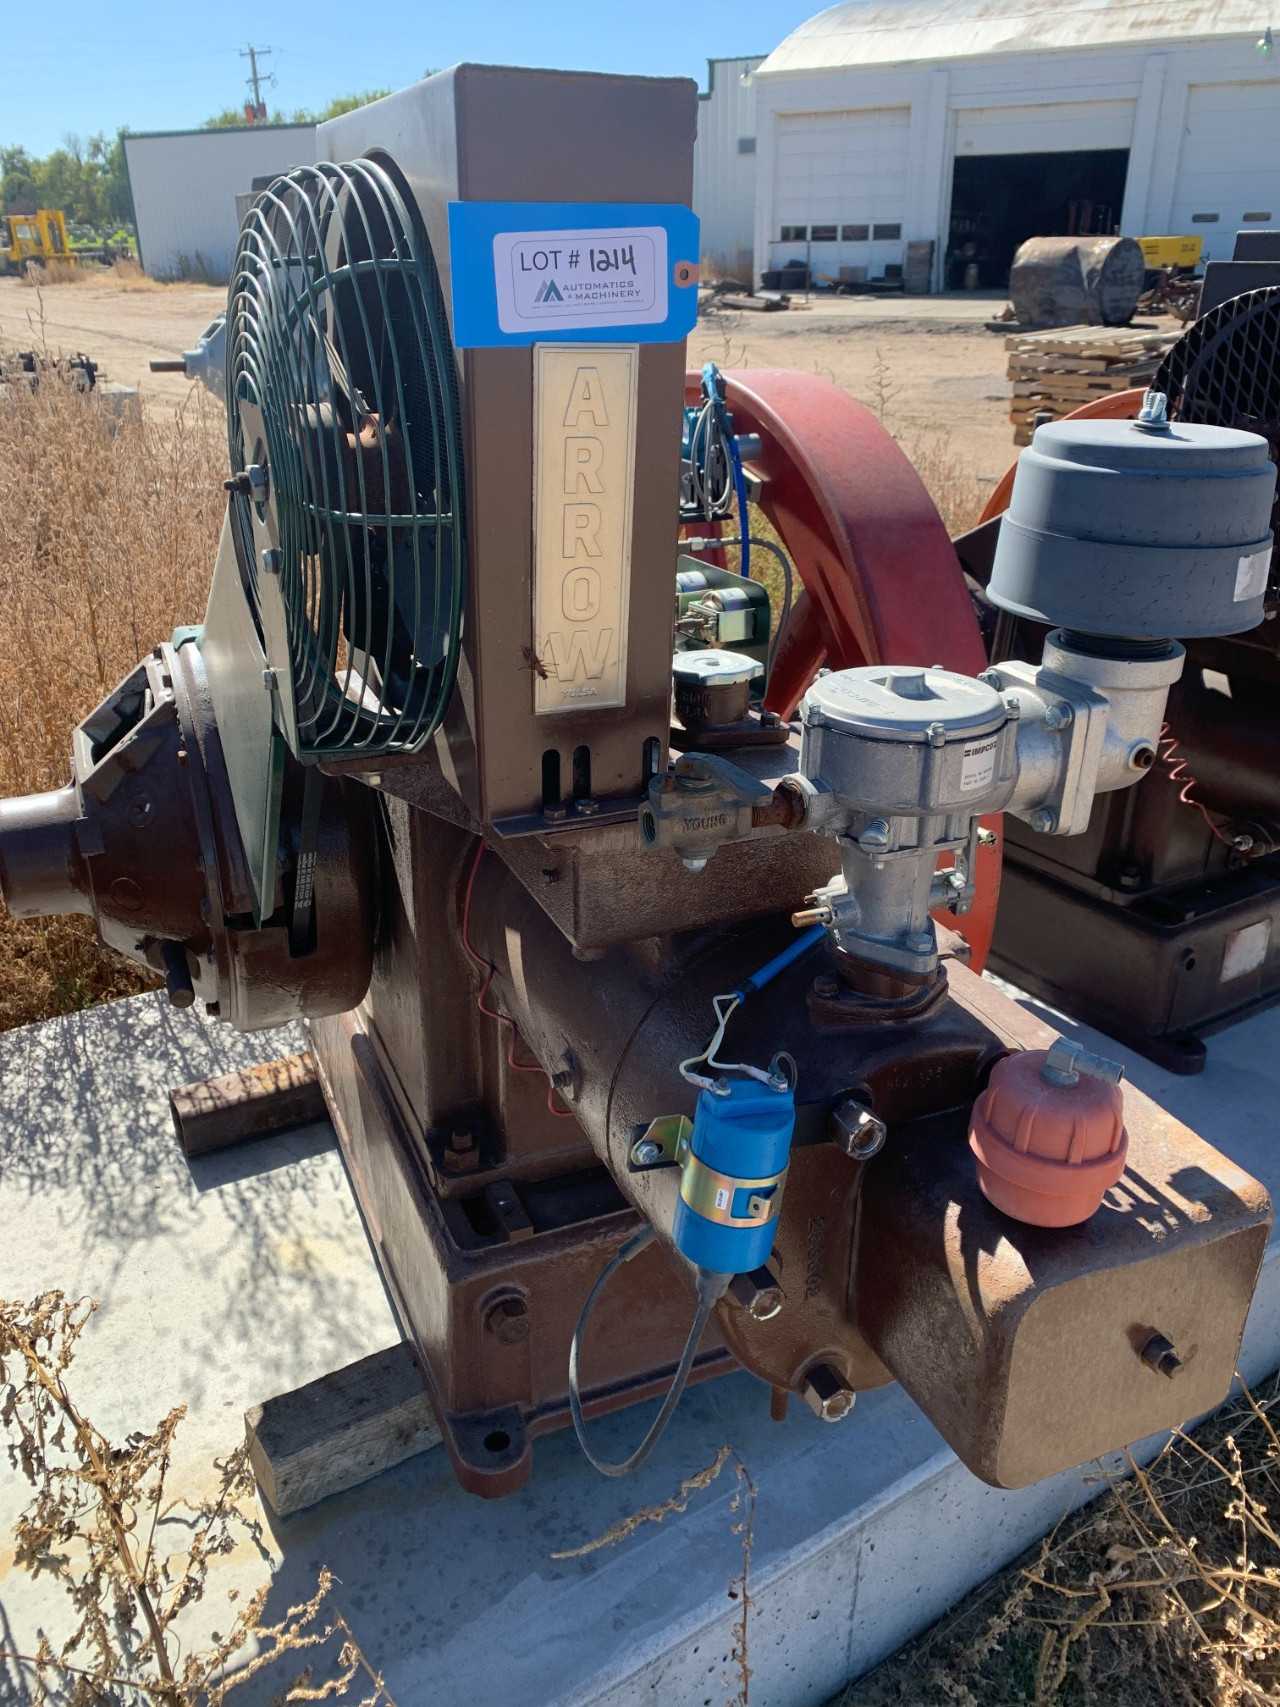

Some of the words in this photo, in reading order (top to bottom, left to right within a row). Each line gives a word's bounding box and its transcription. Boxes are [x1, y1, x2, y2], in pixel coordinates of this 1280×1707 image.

[520, 250, 562, 271] LOT
[568, 249, 580, 269] #
[589, 244, 637, 275] 1214
[562, 280, 635, 291] AUTOMATICS
[575, 289, 641, 300] MACHINERY
[549, 367, 613, 682] ARROW
